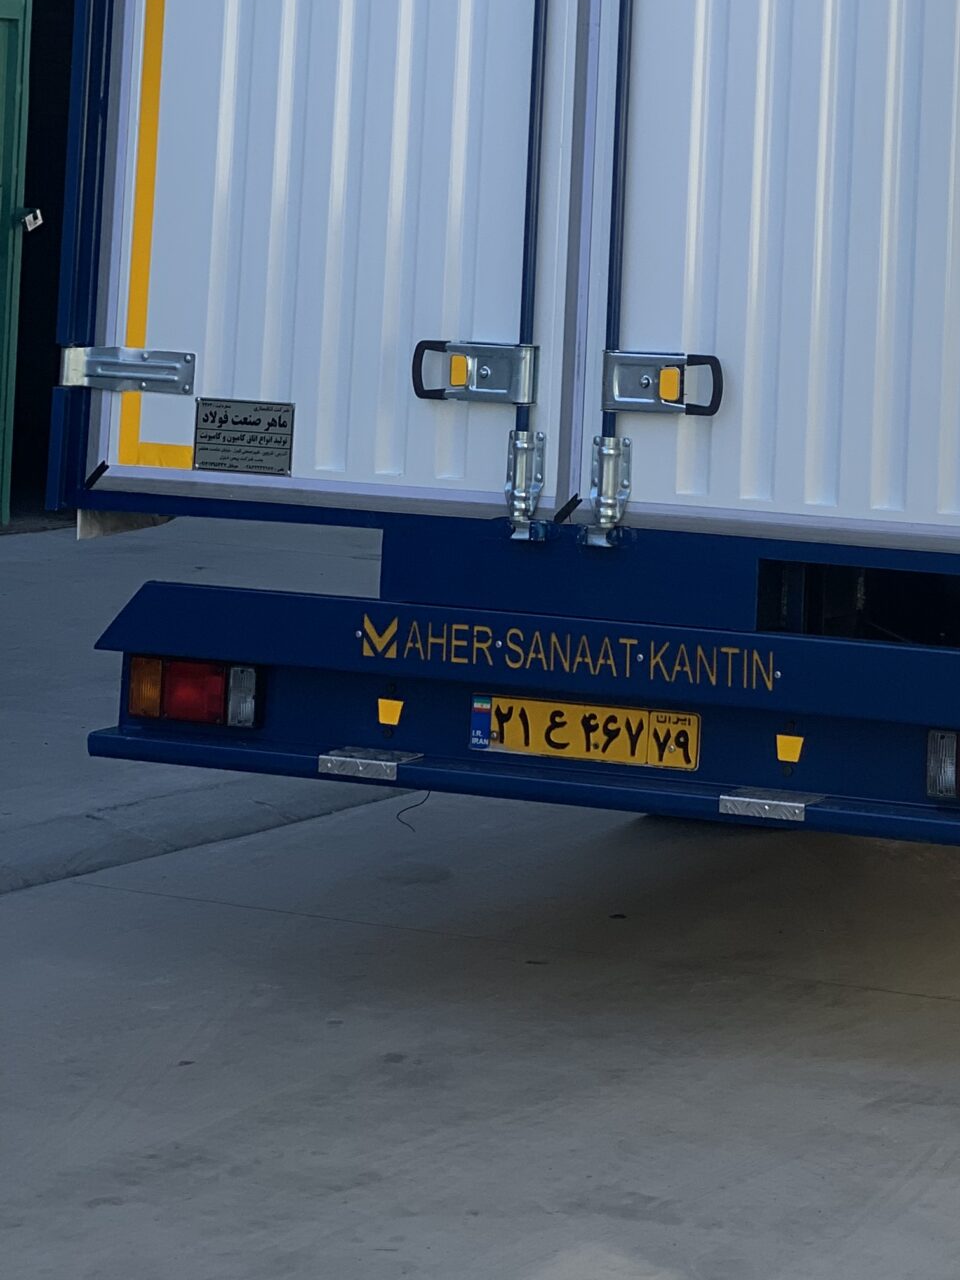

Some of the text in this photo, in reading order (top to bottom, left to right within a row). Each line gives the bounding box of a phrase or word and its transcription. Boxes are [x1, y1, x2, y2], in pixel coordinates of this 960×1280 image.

[202, 410, 288, 431] ماهر صنعت فولاد
[504, 627, 638, 678] SANAAT
[649, 640, 774, 692] KANTIN
[656, 713, 692, 726] ایران
[471, 737, 489, 745] IRAN
